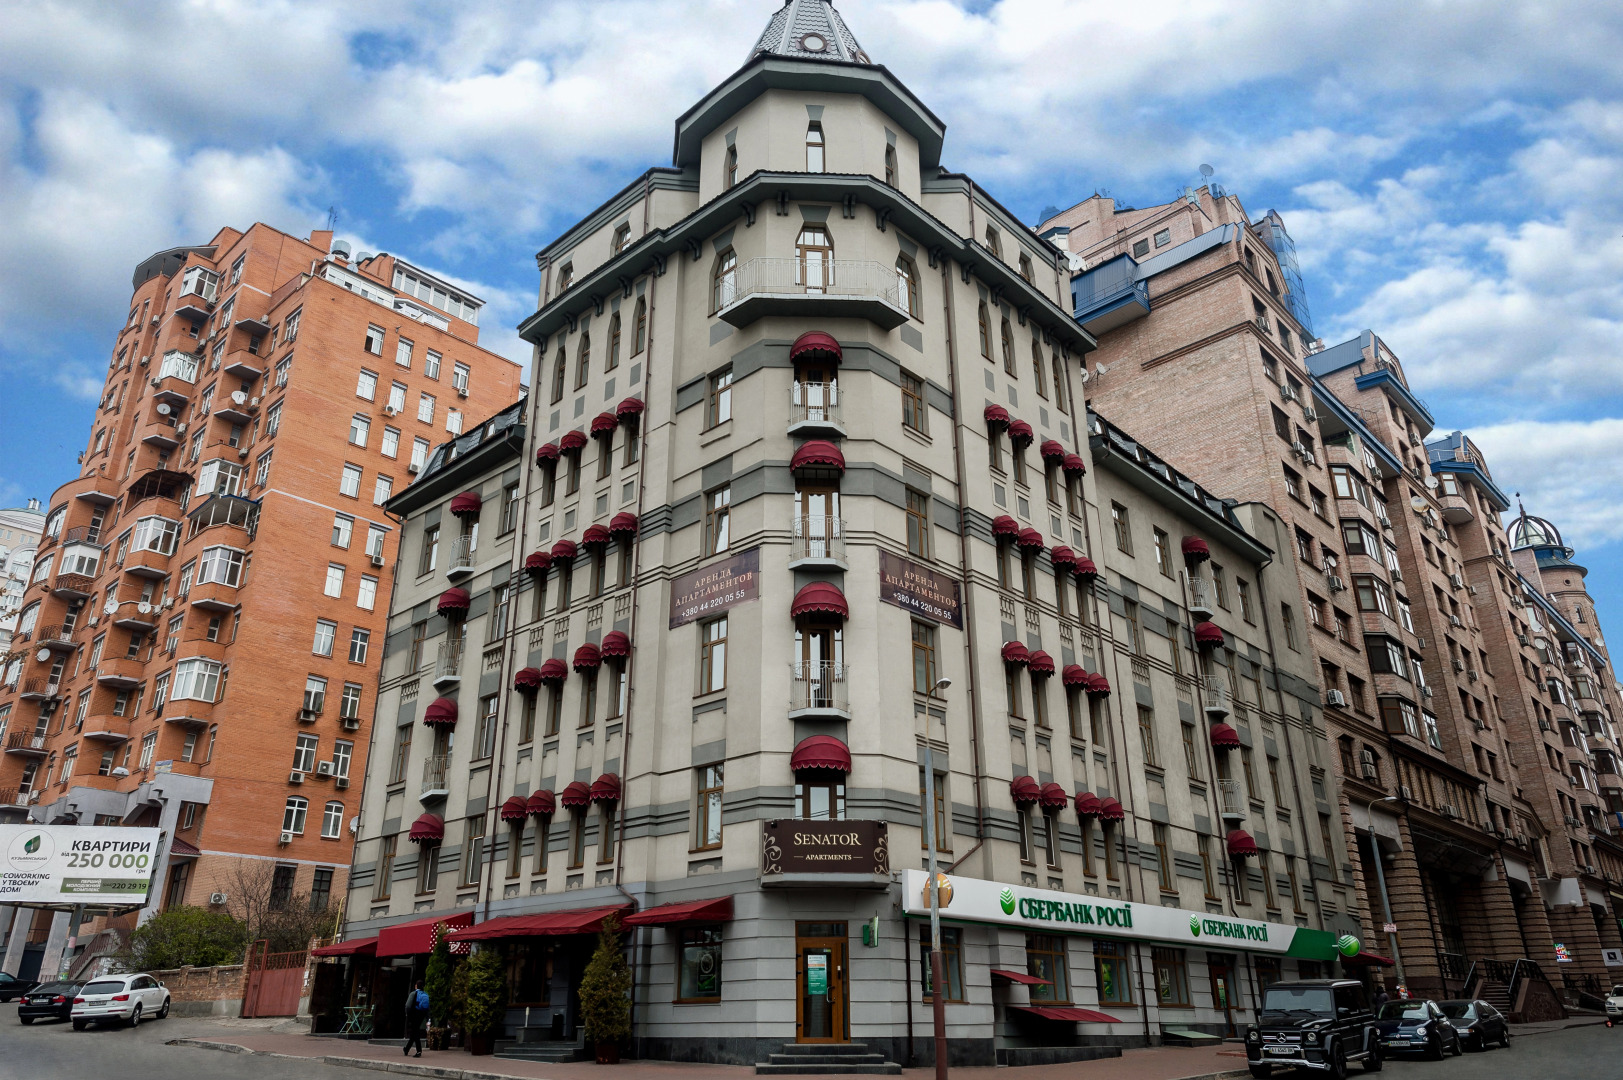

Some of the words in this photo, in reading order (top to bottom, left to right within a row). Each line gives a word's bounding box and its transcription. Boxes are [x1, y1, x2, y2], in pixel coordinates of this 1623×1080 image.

[675, 571, 753, 607] АПАРТАМЕНТОВ
[694, 568, 732, 589] АРЕНДА
[904, 570, 939, 591] АРЕНДА
[885, 574, 957, 608] АПАРТАМЕНТОВ
[681, 605, 699, 617] +380
[700, 602, 709, 611] 44
[710, 596, 724, 608] 220
[725, 593, 734, 603] 05
[736, 589, 745, 599] 55
[893, 592, 910, 604] +380
[910, 598, 919, 608] 44
[920, 601, 933, 613] 220
[933, 607, 942, 617] 05
[943, 610, 952, 620] 55
[71, 840, 151, 852] КВАРТИРИ
[793, 832, 862, 846] SENATOR
[67, 853, 104, 868] 250
[108, 853, 149, 869] 000
[111, 882, 126, 890] 220
[127, 882, 137, 890] 29
[1018, 897, 1095, 925] СБЕРБАНК
[1095, 903, 1133, 928] РОСІЇ
[1202, 918, 1246, 940] СБЕРБАНК
[1246, 923, 1269, 942] РОСІЇ
